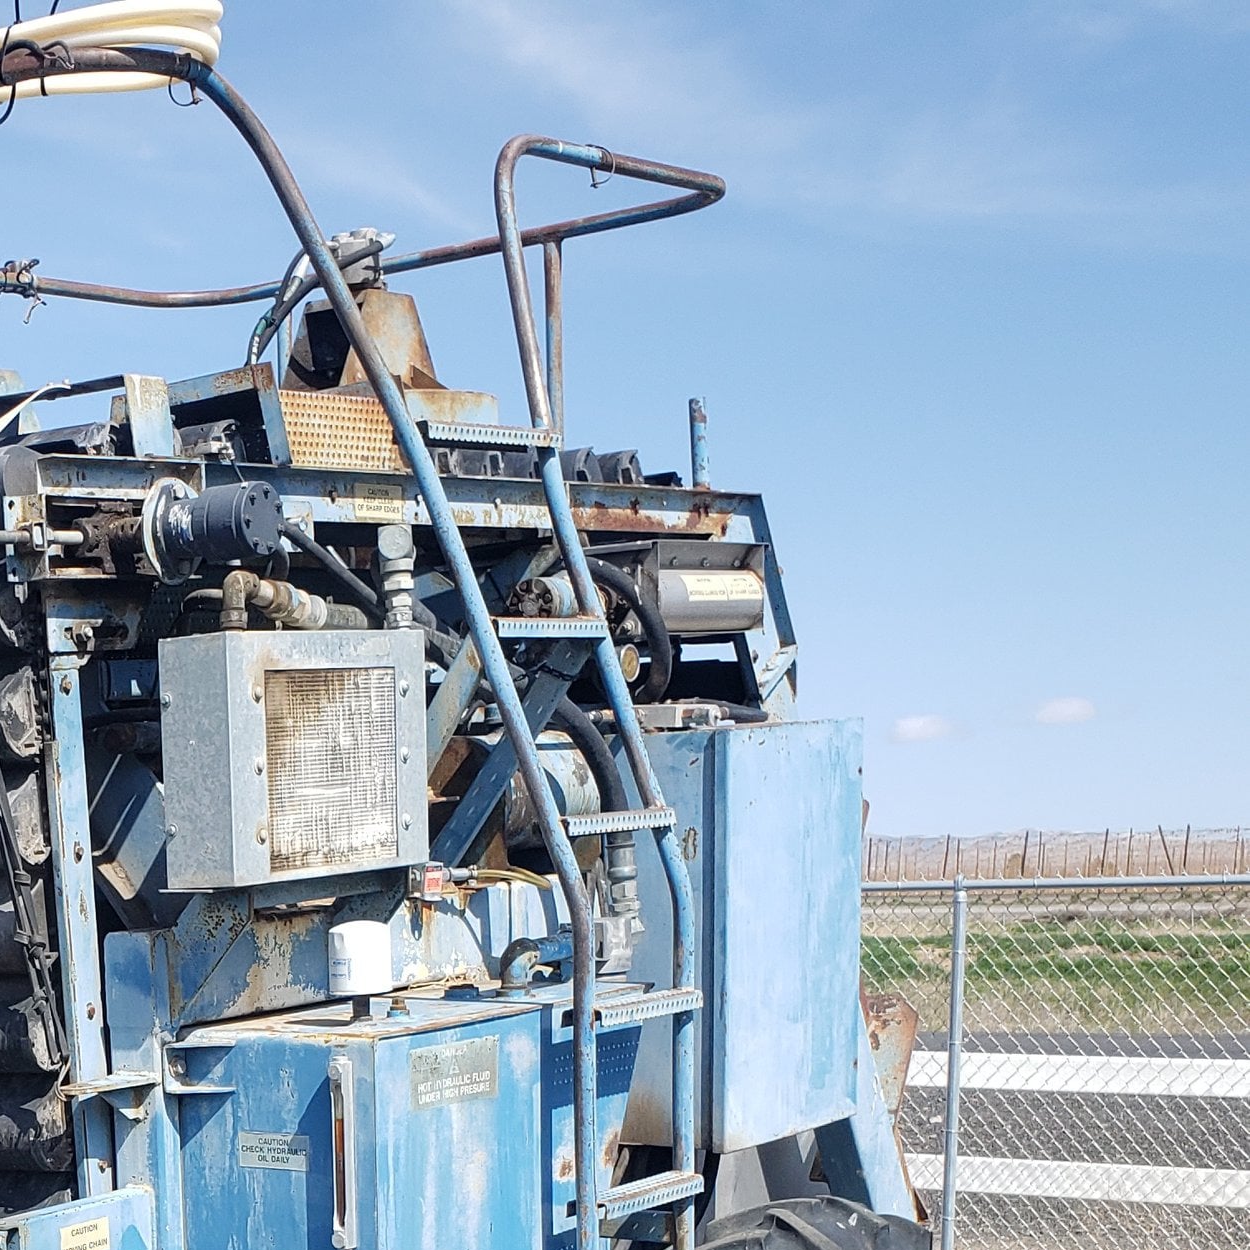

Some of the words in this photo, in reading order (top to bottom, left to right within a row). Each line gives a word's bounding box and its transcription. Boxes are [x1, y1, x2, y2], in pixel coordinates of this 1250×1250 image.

[417, 1081, 432, 1094] HOT
[472, 1071, 491, 1083] FLUID
[418, 1090, 441, 1105] UNDER
[258, 1137, 289, 1147] CAUTION
[240, 1144, 265, 1154] CHECK
[266, 1145, 308, 1157] HYDRAULIC
[257, 1154, 269, 1163] OIL
[270, 1154, 291, 1164] DAILY
[70, 1223, 98, 1237] CAUTION
[88, 1237, 108, 1250] CHAIN
